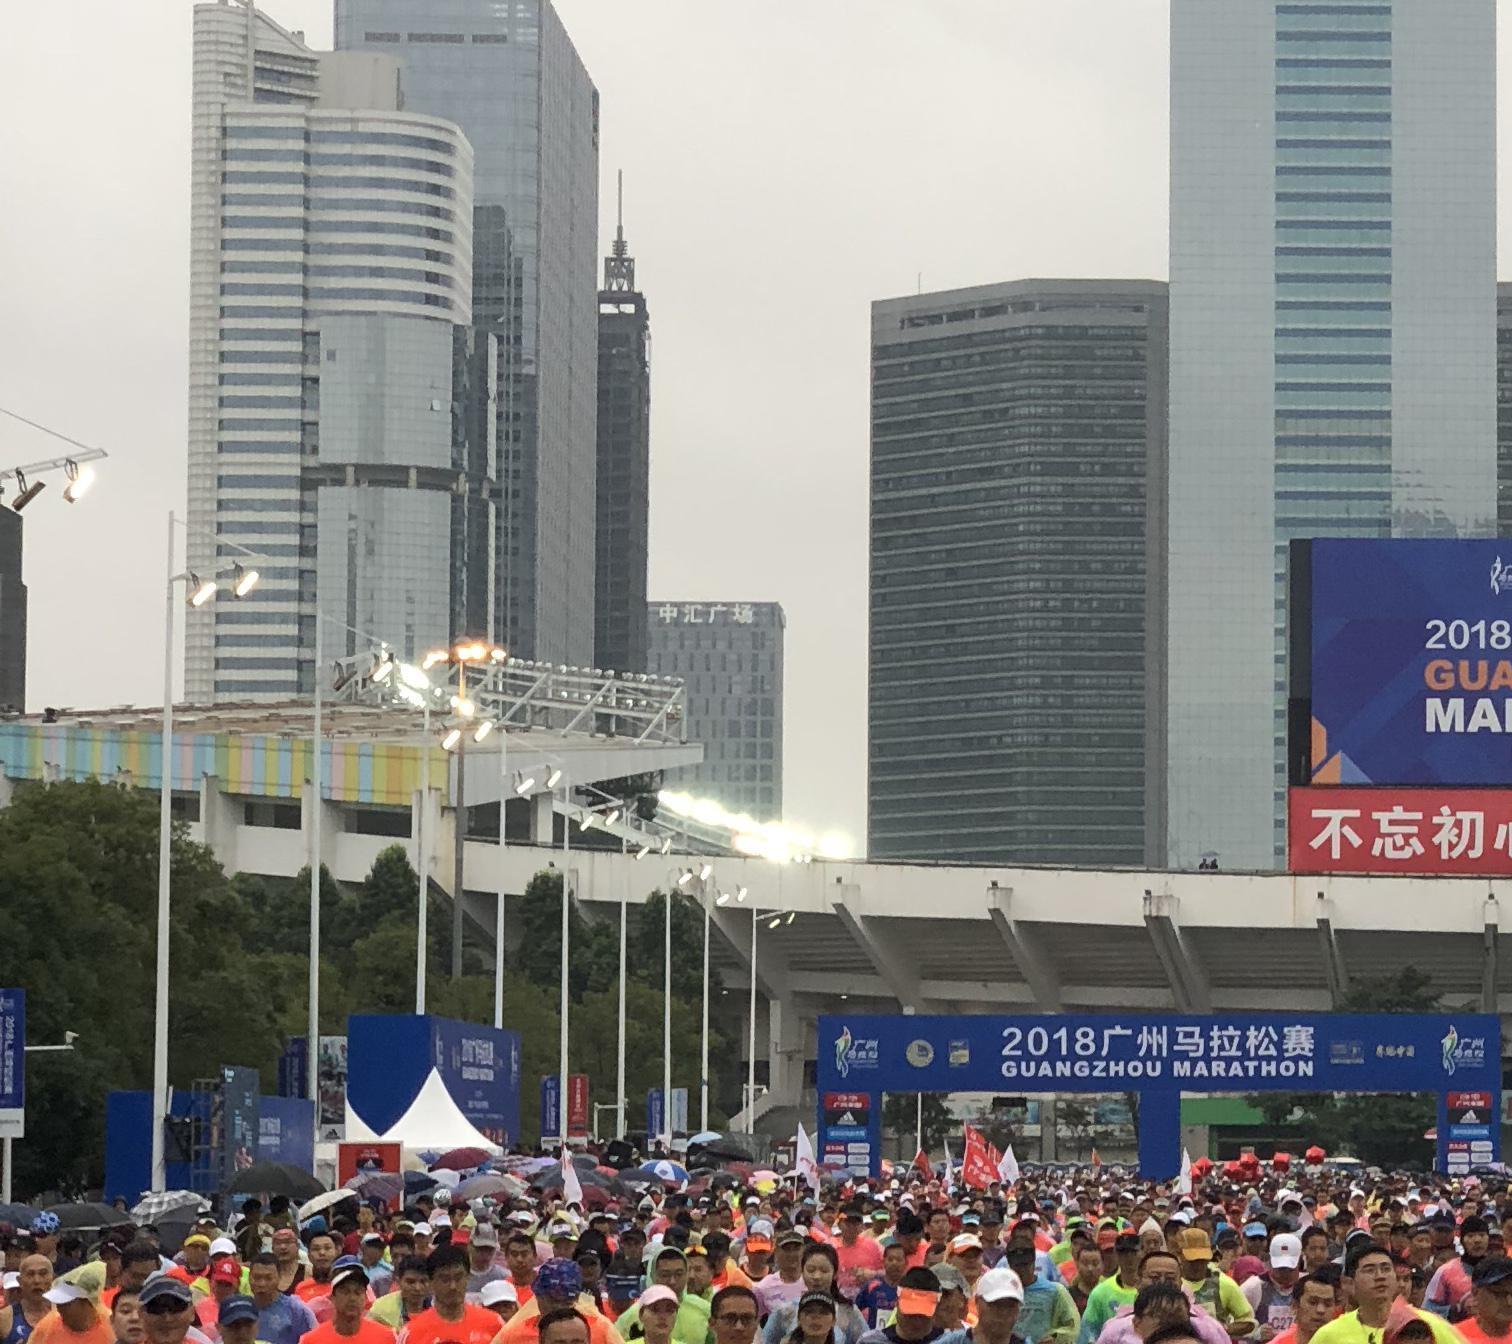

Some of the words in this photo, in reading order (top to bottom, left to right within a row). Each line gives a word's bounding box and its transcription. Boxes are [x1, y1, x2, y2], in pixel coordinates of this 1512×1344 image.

[659, 603, 753, 624] 中汇广场
[1001, 1025, 1315, 1058] 2018广州马拉松赛
[1001, 1060, 1161, 1078] GUANGZHOU
[1172, 1060, 1315, 1078] MARATHON
